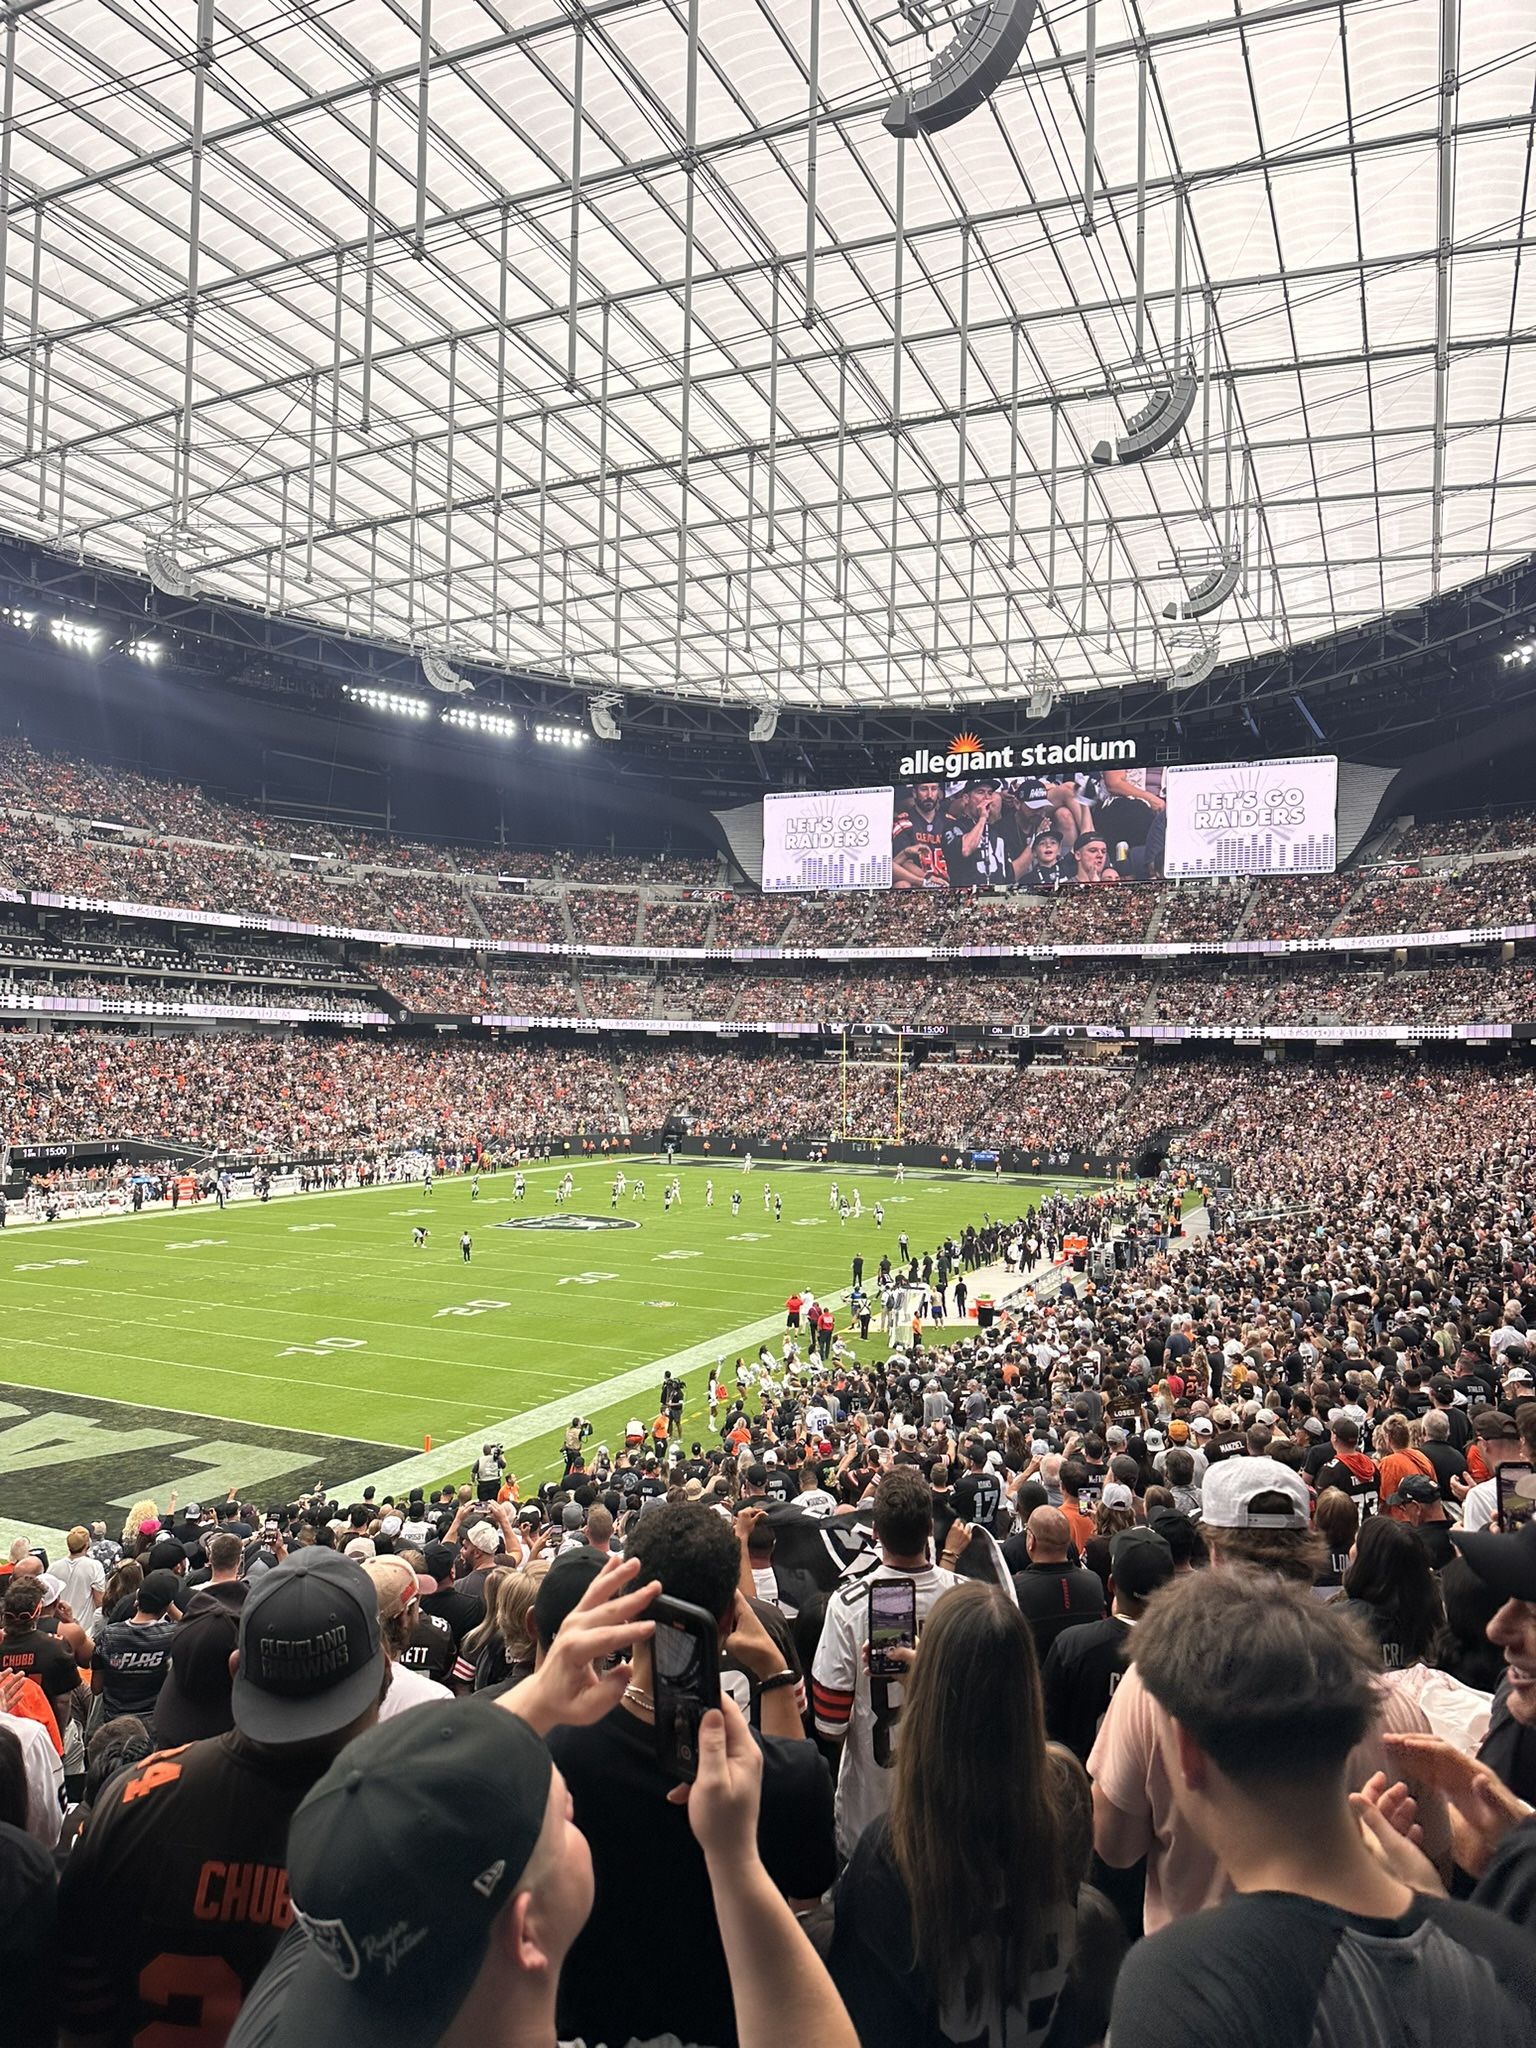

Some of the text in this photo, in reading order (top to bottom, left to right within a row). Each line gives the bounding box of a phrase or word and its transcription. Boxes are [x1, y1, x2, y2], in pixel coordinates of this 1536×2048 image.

[899, 748, 1014, 778] allegiant
[1020, 736, 1136, 767] stadium
[1196, 787, 1305, 812] LET'S GO
[786, 814, 869, 834] LET'S GO
[1194, 807, 1306, 830] RAIDERS
[785, 831, 869, 851] RAIDERS
[923, 1026, 945, 1035] 15:00
[45, 1146, 68, 1156] 15:00
[555, 1271, 621, 1286] 30
[432, 1299, 512, 1319] 20
[274, 1337, 368, 1357] 10
[971, 1489, 999, 1524] 17
[260, 1624, 347, 1657] CLEVELAND
[2, 1653, 35, 1668] CHUBB
[118, 1650, 164, 1670] FLAG
